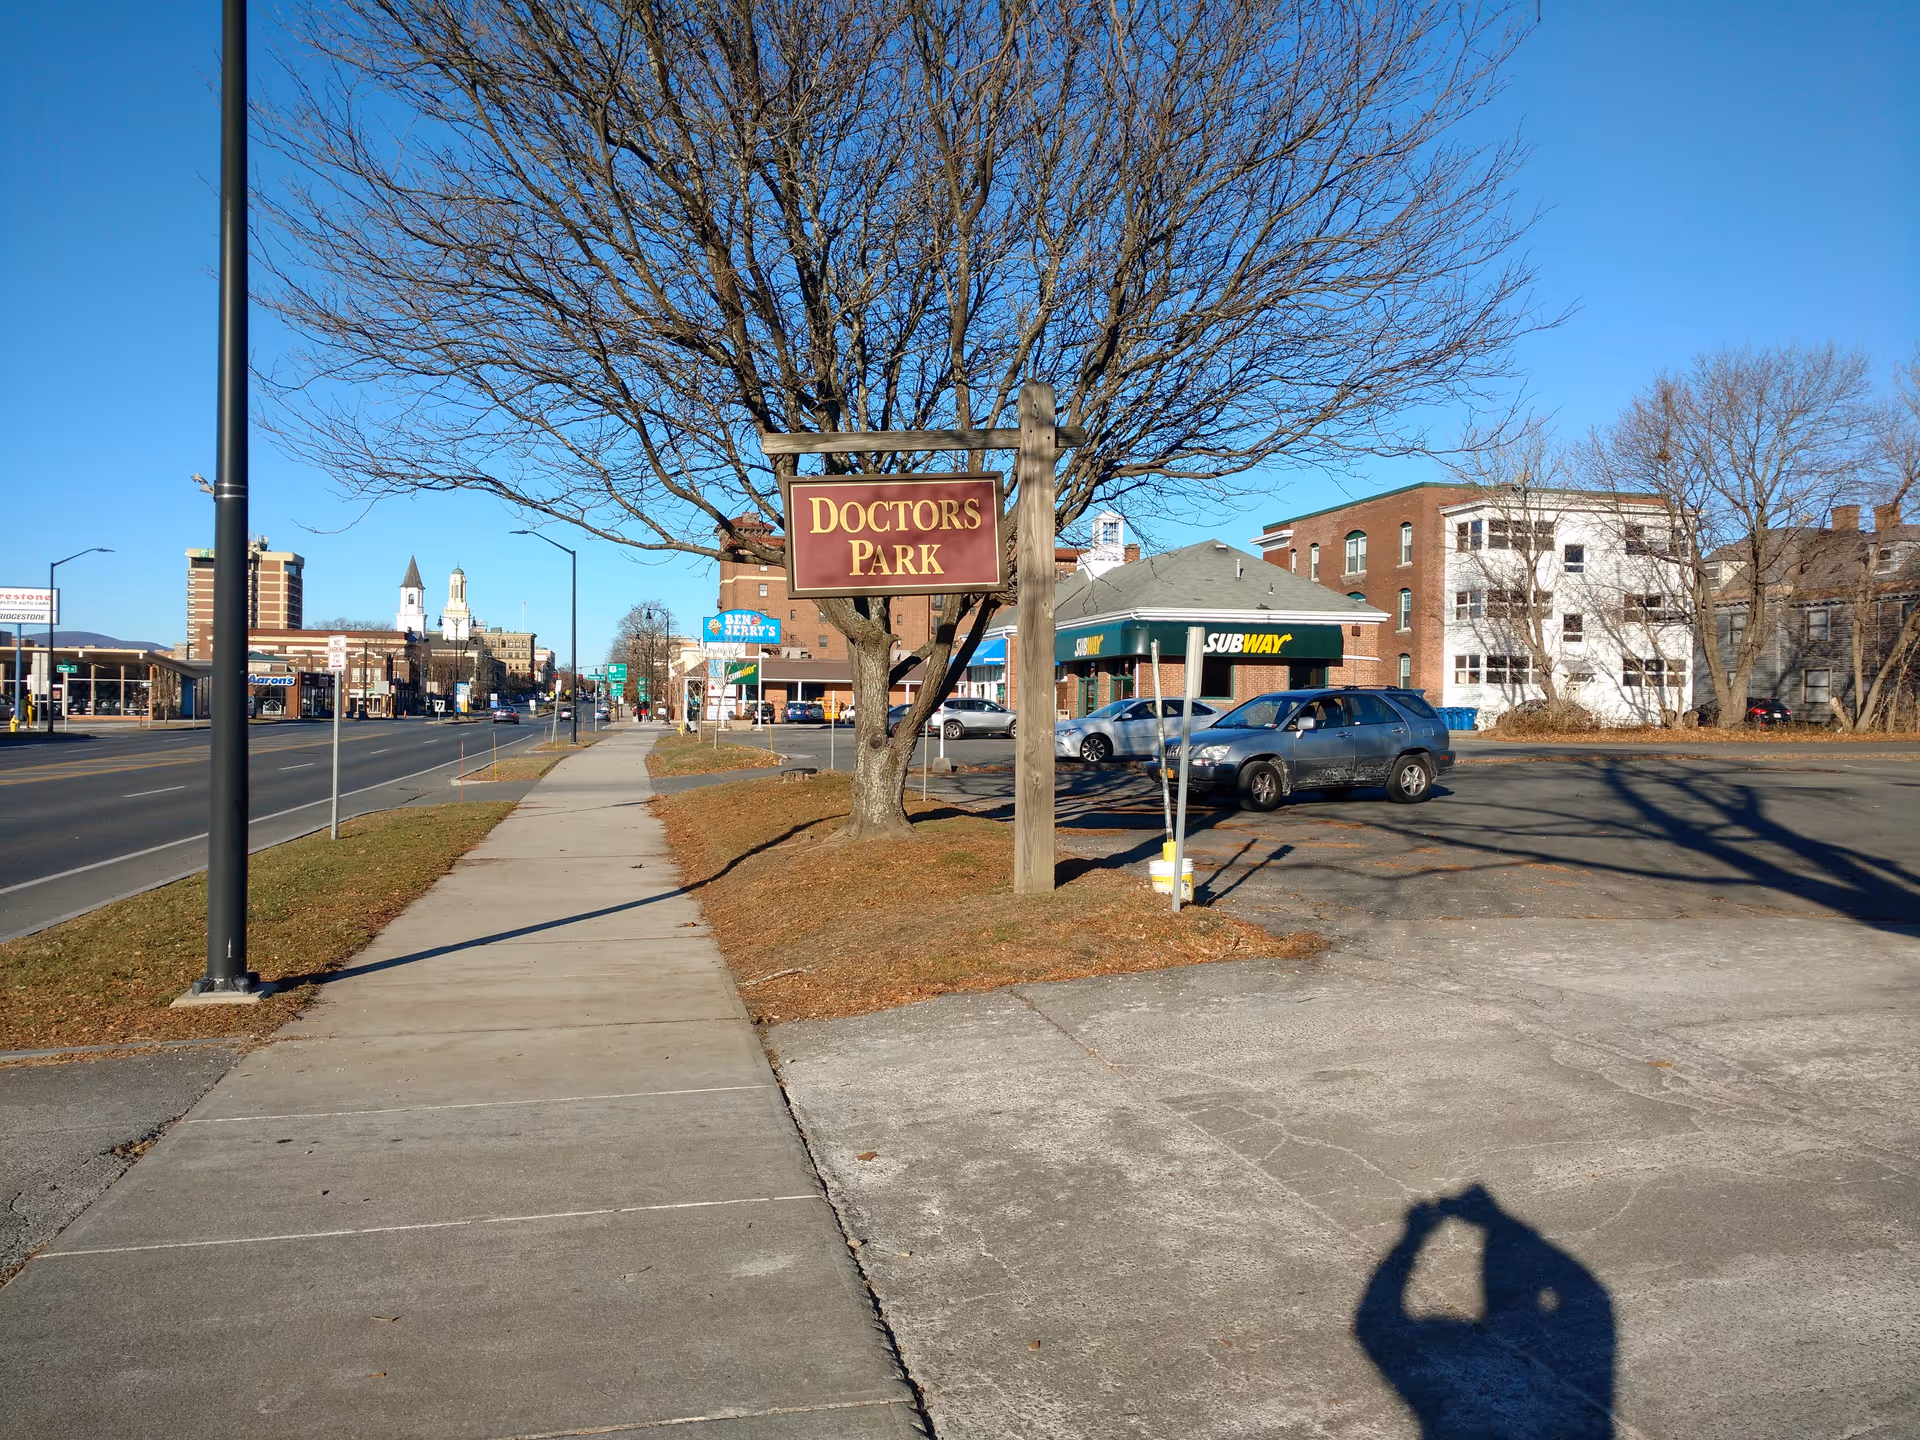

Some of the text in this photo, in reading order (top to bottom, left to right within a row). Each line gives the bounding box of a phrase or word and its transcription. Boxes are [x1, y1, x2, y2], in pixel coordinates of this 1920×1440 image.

[809, 497, 982, 534] DOCTORS
[848, 539, 945, 576] PARK
[724, 614, 751, 625] BEN
[724, 624, 776, 637] JERRY'S
[1074, 633, 1104, 657] SUBWAY
[1203, 633, 1293, 654] SUBWAY
[248, 674, 295, 686] Aaron's
[727, 664, 757, 683] SUBWAY
